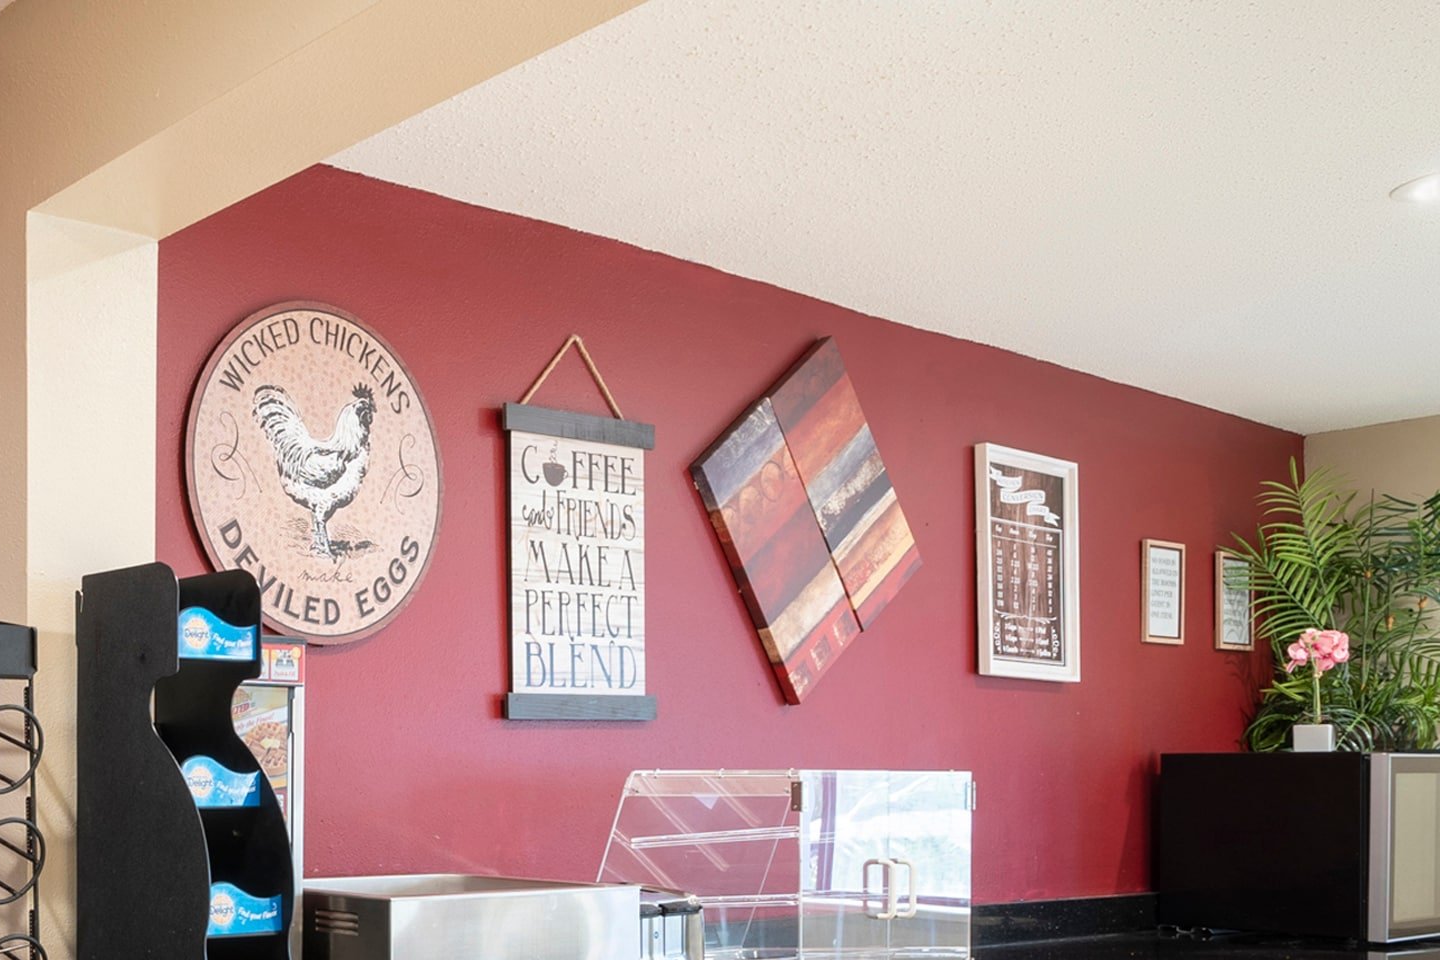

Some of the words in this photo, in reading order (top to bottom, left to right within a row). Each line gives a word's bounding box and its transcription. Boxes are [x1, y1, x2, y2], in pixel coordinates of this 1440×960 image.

[219, 317, 300, 392] WICKED
[310, 316, 410, 414] CHICKENS
[556, 490, 636, 542] FRIENDS
[219, 519, 341, 625] DEVILED
[355, 536, 420, 618] EGGS
[299, 566, 354, 583] make
[524, 540, 611, 587] MAKE
[619, 549, 637, 591] A
[525, 588, 638, 642] PERFECT
[525, 641, 637, 690] BLEND
